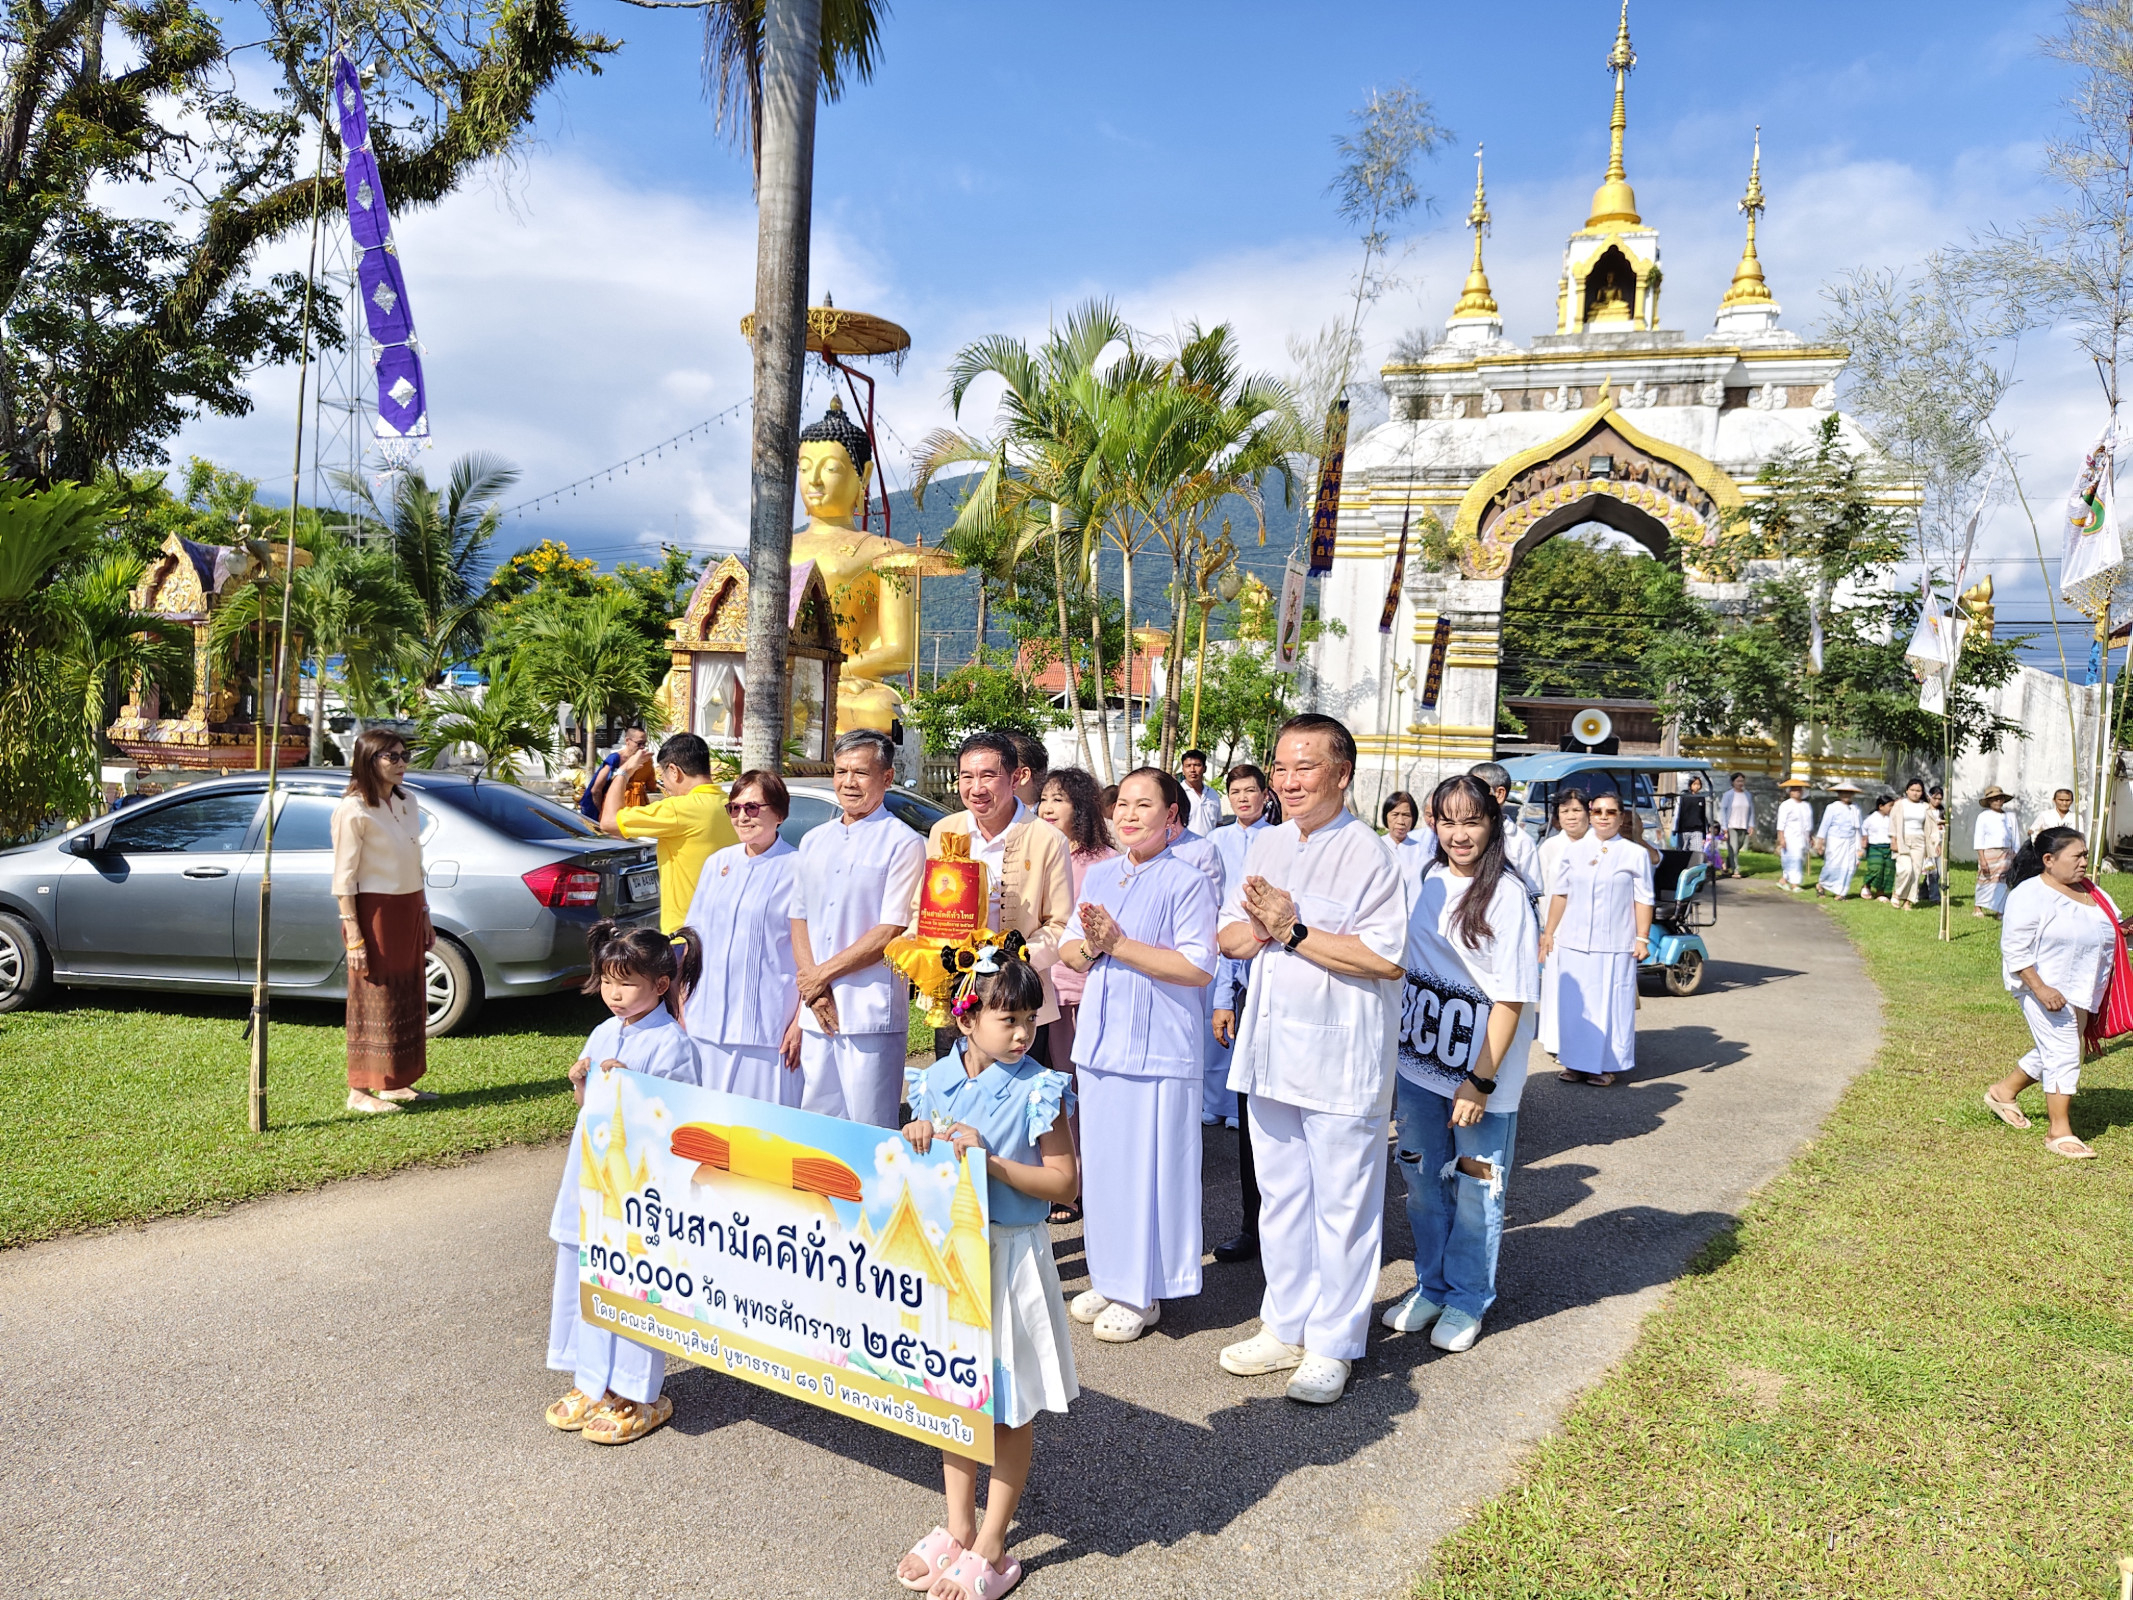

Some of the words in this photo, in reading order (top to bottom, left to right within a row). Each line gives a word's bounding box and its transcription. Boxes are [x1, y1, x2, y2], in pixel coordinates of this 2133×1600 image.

[590, 1243, 693, 1298] ๓๐,๐๐๐
[702, 1275, 727, 1310] วัด
[733, 1294, 851, 1349] พุทธศักราช
[861, 1323, 977, 1388] ๒๕๖๘
[625, 1187, 923, 1308] กฐินสามัคคีทั่วไทย
[593, 1296, 616, 1319] โดย
[620, 1313, 719, 1356] คณะศิษยานุศิษย์
[723, 1347, 790, 1382] บูชาธรรม
[796, 1374, 818, 1392] ๘๑
[823, 1376, 834, 1396] ปี
[840, 1386, 972, 1443] หลวงพ่อธัมมชโย
